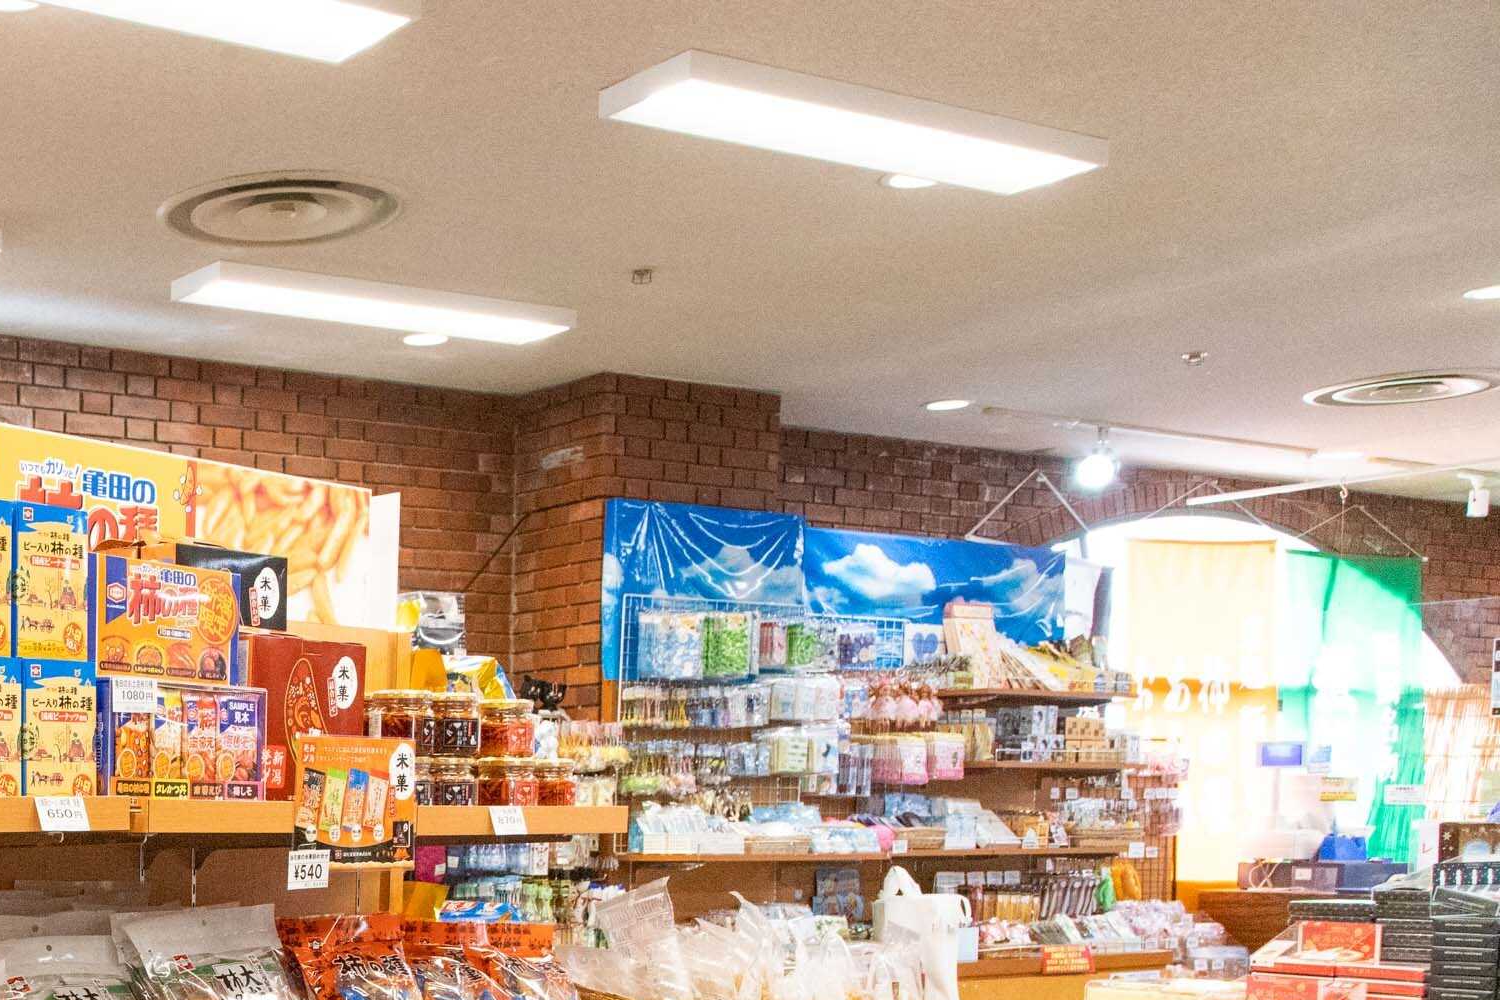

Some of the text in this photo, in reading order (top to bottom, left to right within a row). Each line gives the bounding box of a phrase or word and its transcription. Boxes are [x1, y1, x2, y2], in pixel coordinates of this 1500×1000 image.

[82, 469, 156, 505] 亀田の
[260, 577, 273, 611] 米菓
[338, 665, 350, 701] 米菓
[32, 695, 92, 711] ピー入り柿の種
[122, 690, 154, 701] 1080円
[229, 701, 255, 711] SAMPLE
[234, 712, 250, 723] 見本
[396, 752, 409, 793] 米菓
[47, 808, 84, 820] 650円
[294, 863, 323, 881] ¥540
[332, 954, 411, 977] 柿の種
